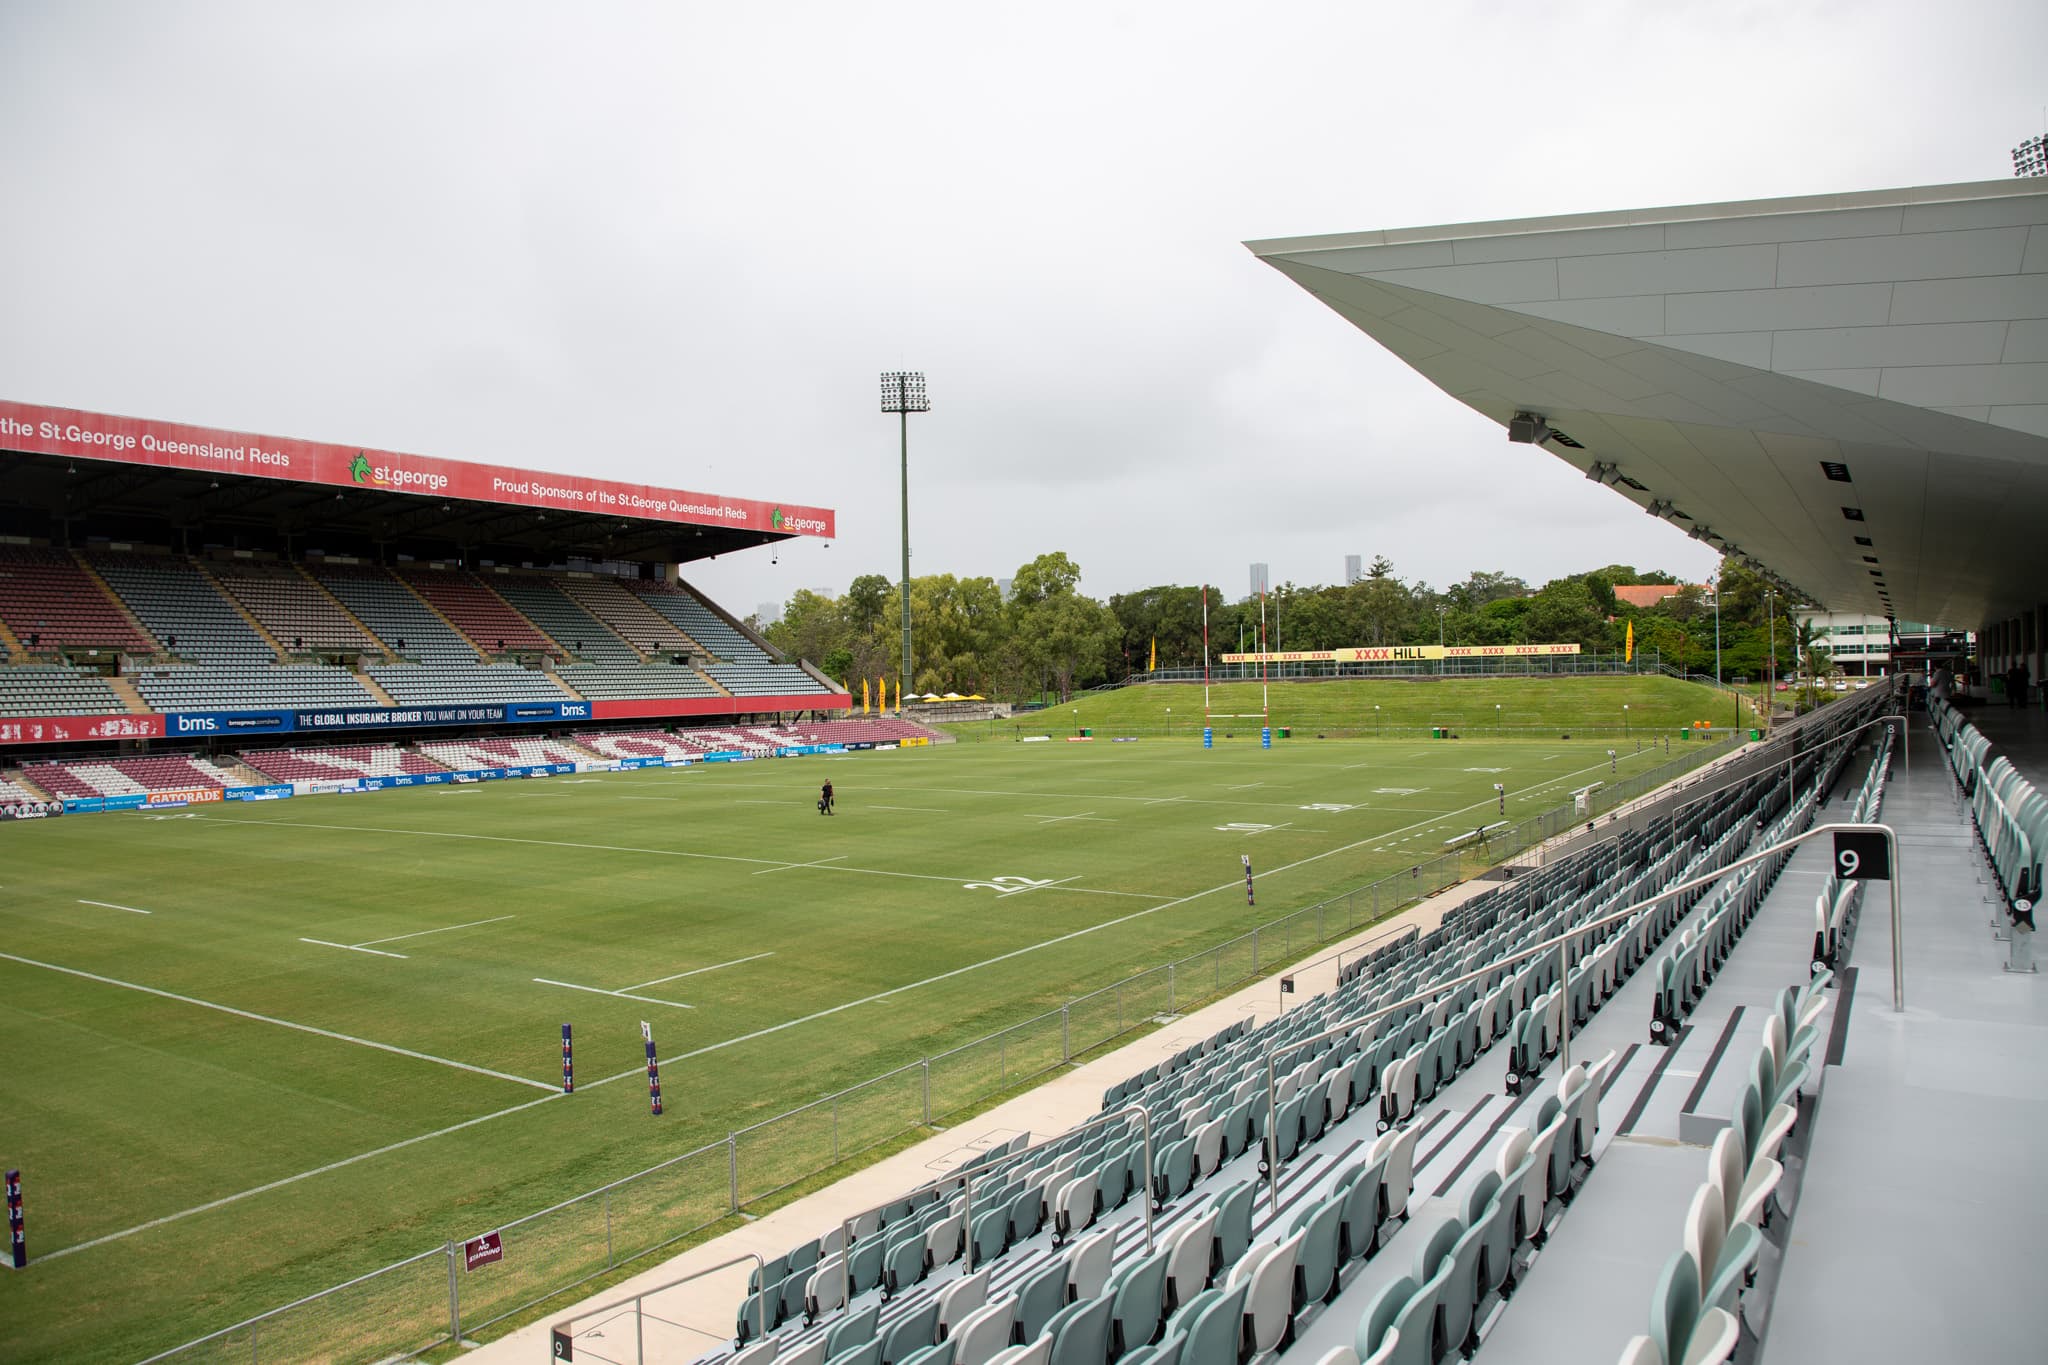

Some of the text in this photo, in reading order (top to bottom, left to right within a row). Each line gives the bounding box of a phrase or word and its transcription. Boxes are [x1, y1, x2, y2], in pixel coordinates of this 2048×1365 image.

[0, 418, 290, 466] the St.George Queensland Reds
[374, 466, 448, 489] st.george
[493, 478, 747, 520] Proud Sponsors of the St.George Queensland Reds
[784, 515, 826, 532] st.george
[1355, 648, 1426, 660] XXXX HILL
[299, 708, 503, 726] THE GLOBAL INSURANCE BROKER YOU WANT ON YOUR TEAM
[1887, 724, 1895, 734] 8
[150, 790, 221, 803] GATORADE
[1840, 849, 1860, 876] 9
[963, 876, 1054, 893] 22
[1282, 983, 1288, 992] 8
[478, 1243, 490, 1251] NO
[555, 1341, 563, 1356] 9
